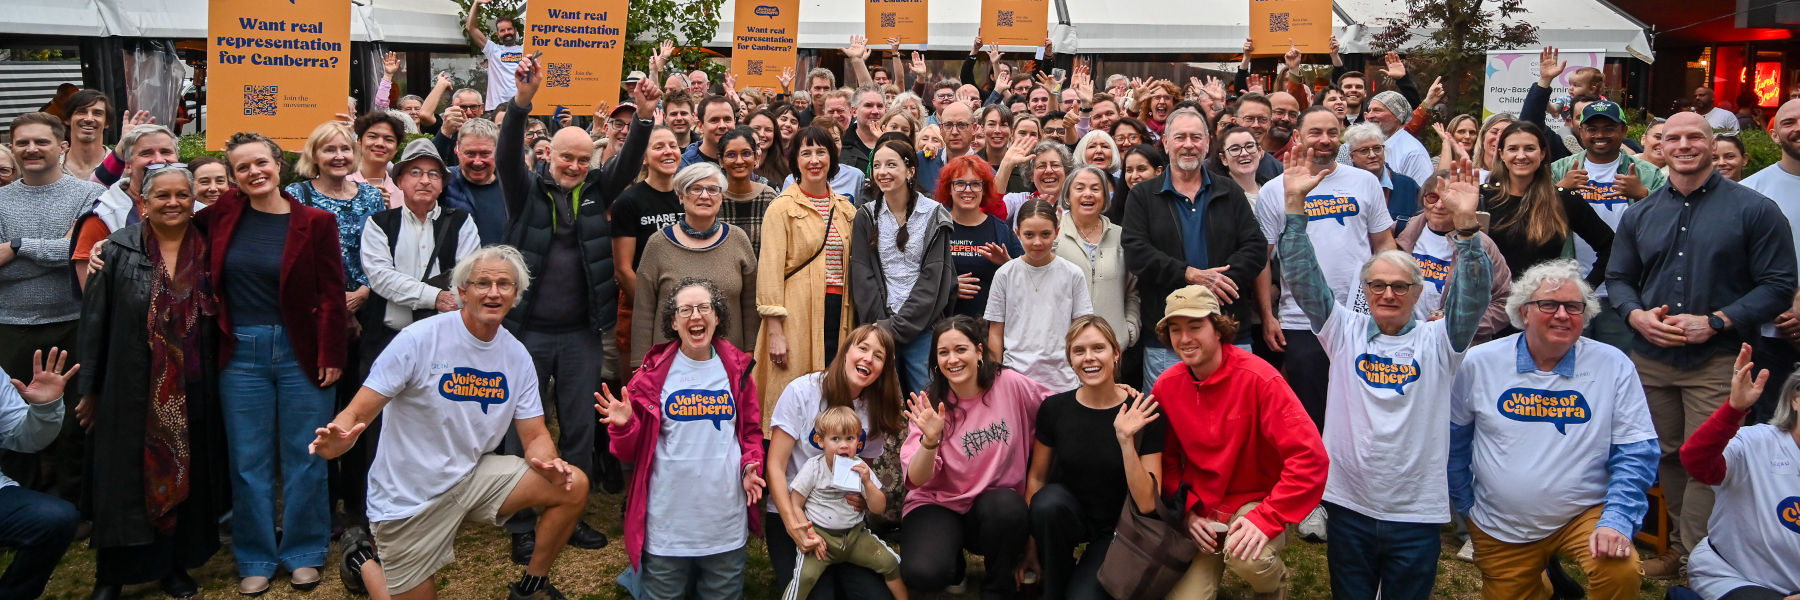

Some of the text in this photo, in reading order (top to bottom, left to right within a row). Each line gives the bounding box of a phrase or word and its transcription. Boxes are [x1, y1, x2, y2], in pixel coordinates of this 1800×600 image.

[547, 9, 608, 21] Want real
[239, 17, 323, 34] Want real
[531, 24, 620, 36] representation
[747, 26, 768, 34] Want
[216, 36, 342, 52] representation
[532, 36, 617, 49] for Canberra?
[737, 35, 794, 44] representation
[751, 44, 792, 52] Canberra?
[219, 51, 339, 69] for Canberra?
[1490, 86, 1530, 94] Play-Base
[1498, 96, 1525, 104] Childr
[1305, 203, 1357, 216] anberra
[641, 212, 676, 226] SHARE
[452, 373, 503, 388] Voices of
[443, 380, 505, 400] Canberra
[675, 393, 729, 406] Voices of
[1511, 393, 1578, 407] Voices of
[668, 402, 733, 416] Canberra
[1502, 400, 1586, 419] Canberra
